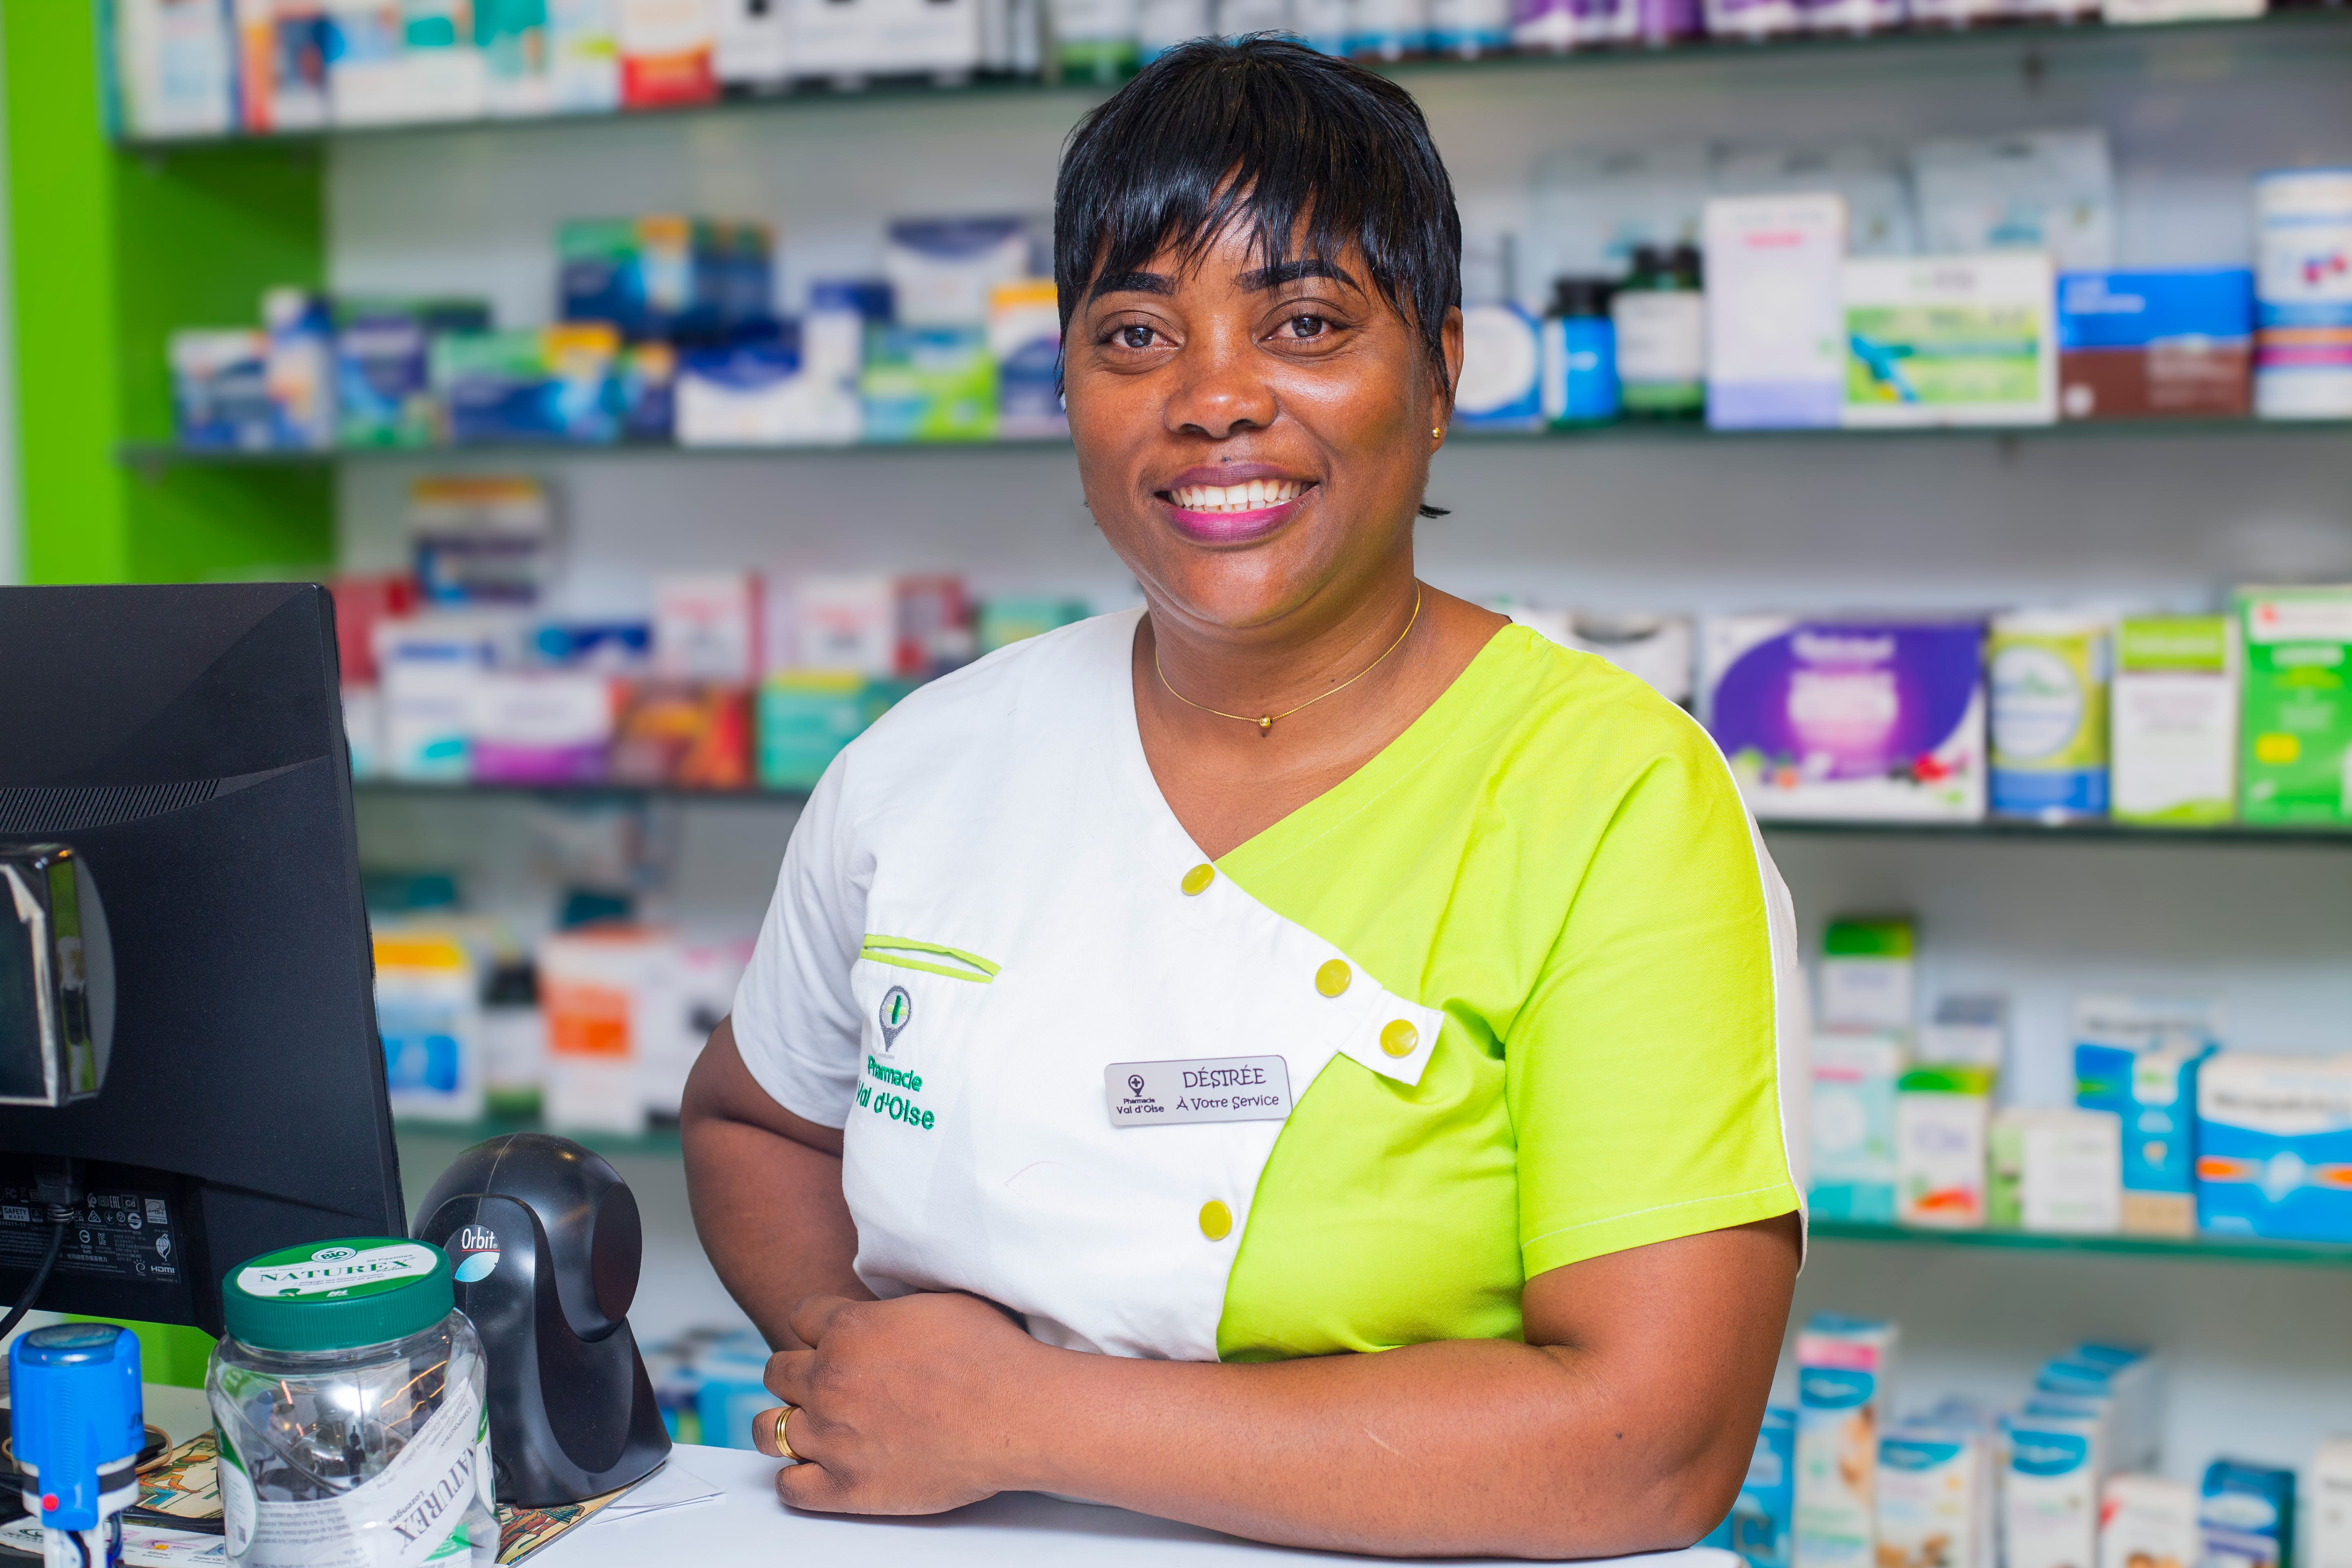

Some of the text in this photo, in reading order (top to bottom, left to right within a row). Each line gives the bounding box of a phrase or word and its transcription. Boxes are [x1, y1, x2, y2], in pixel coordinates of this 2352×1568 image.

[1183, 1065, 1266, 1089] DÉSIRÉE
[857, 1080, 872, 1107] Val
[1116, 1105, 1132, 1114] Val
[1176, 1095, 1279, 1111] À Votre Service
[4, 1207, 27, 1216] SAFETY
[321, 1251, 347, 1259] BIO
[151, 1265, 175, 1274] HDMI
[258, 1259, 411, 1283] NATUREX
[388, 1490, 425, 1525] Lozenges
